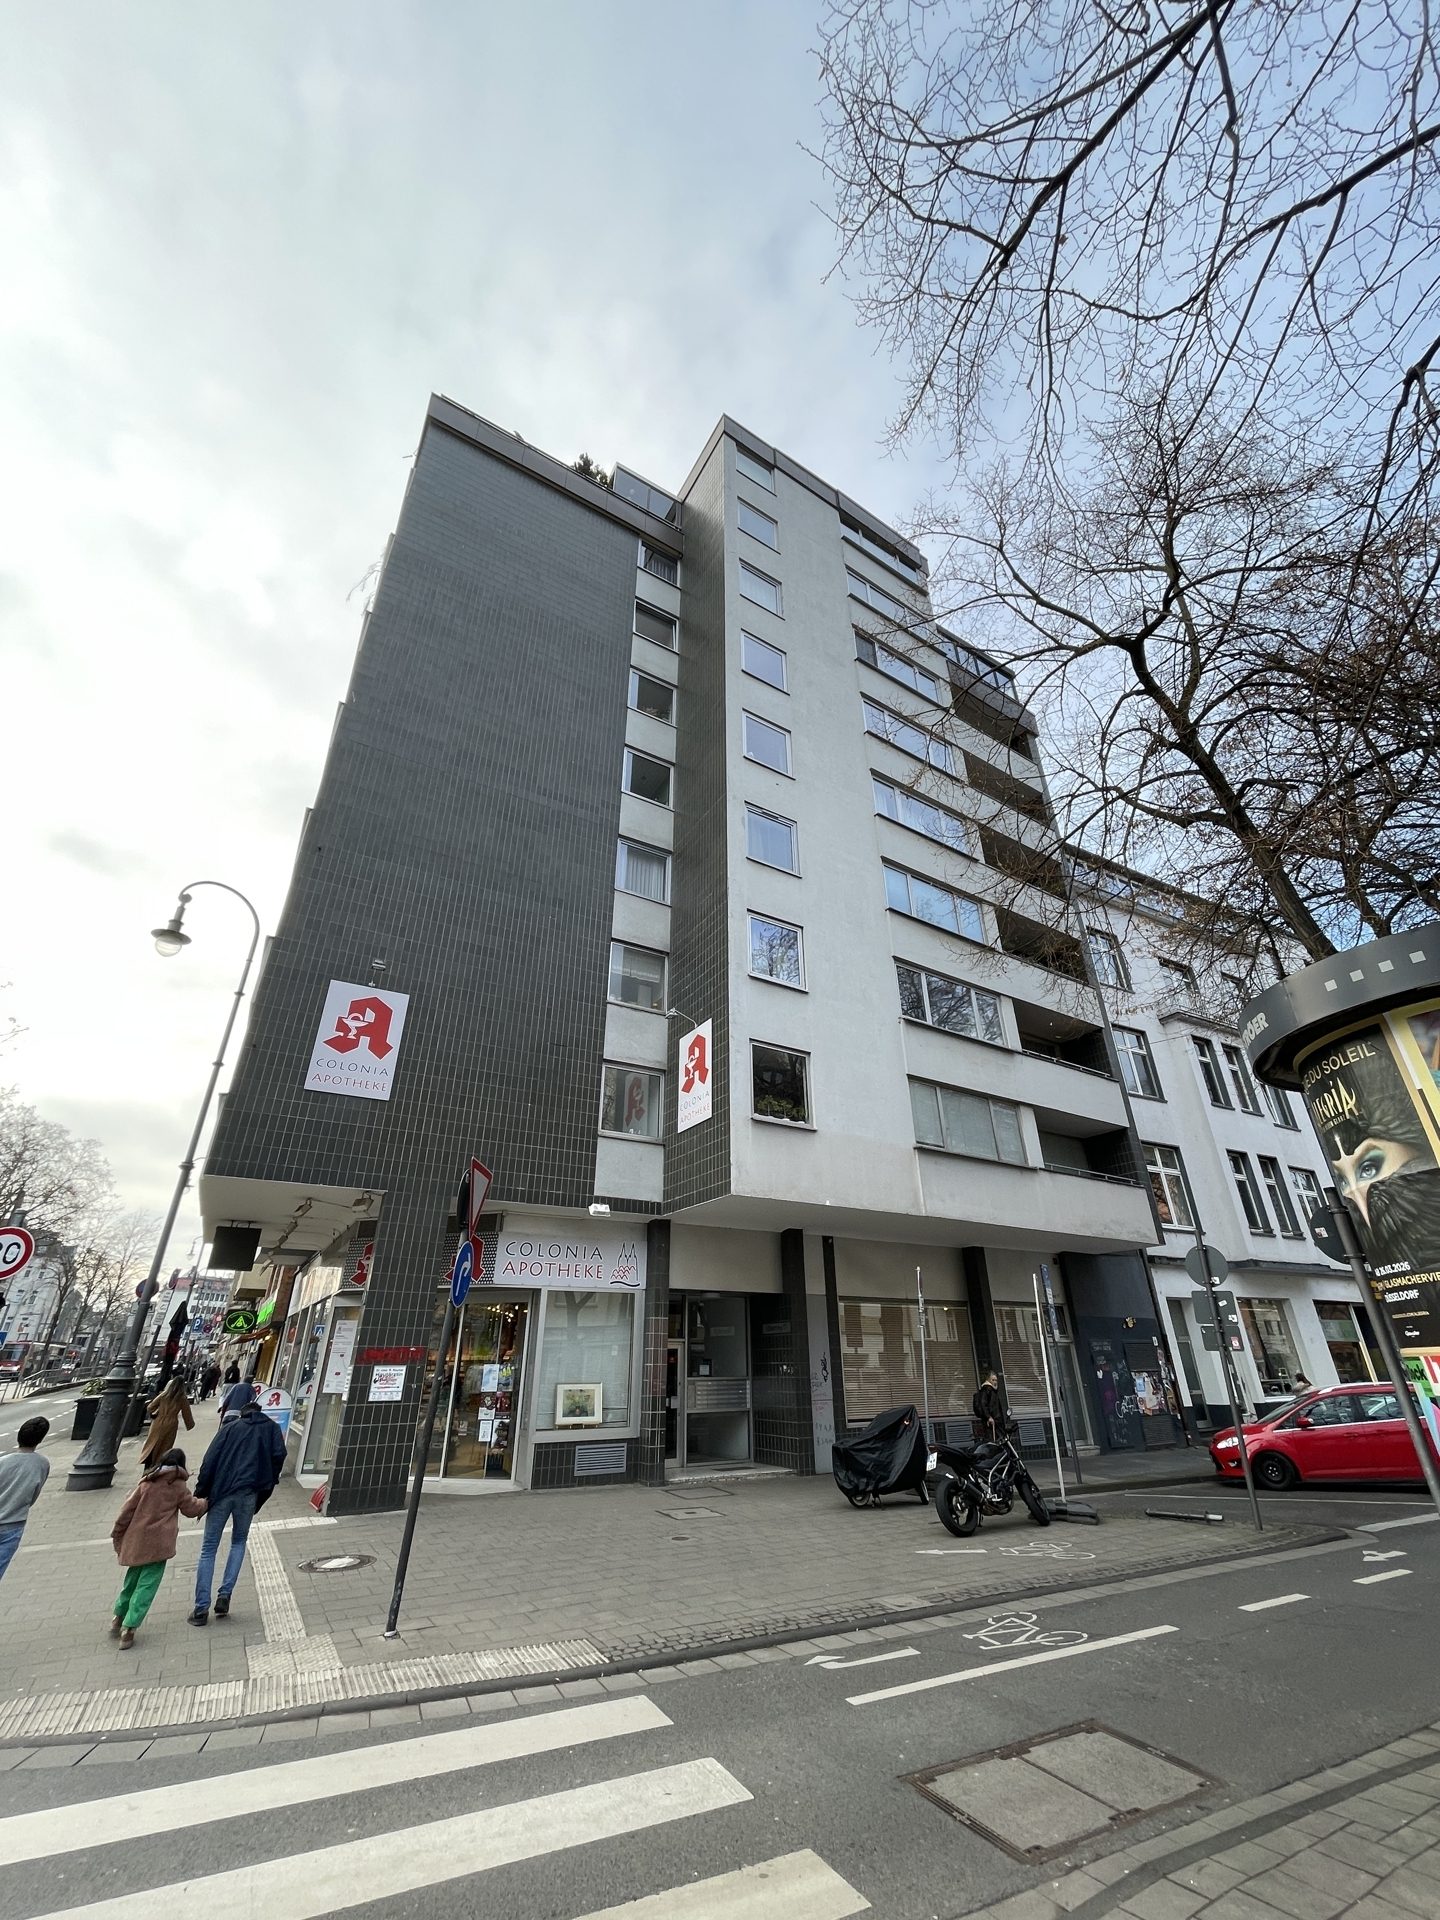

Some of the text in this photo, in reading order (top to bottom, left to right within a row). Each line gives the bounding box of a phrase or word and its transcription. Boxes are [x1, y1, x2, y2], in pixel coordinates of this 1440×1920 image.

[1242, 1012, 1269, 1048] RÖER
[316, 1058, 389, 1077] COLONIA
[1307, 1065, 1322, 1084] DU
[1322, 1043, 1376, 1074] SOLEIL
[312, 1073, 388, 1092] APOTHEKE
[679, 1091, 710, 1112] COLONIA
[679, 1102, 710, 1125] APOTHEKE
[0, 1242, 22, 1265] 0
[505, 1241, 604, 1261] COLONIA
[502, 1260, 604, 1280] APOTHEKE
